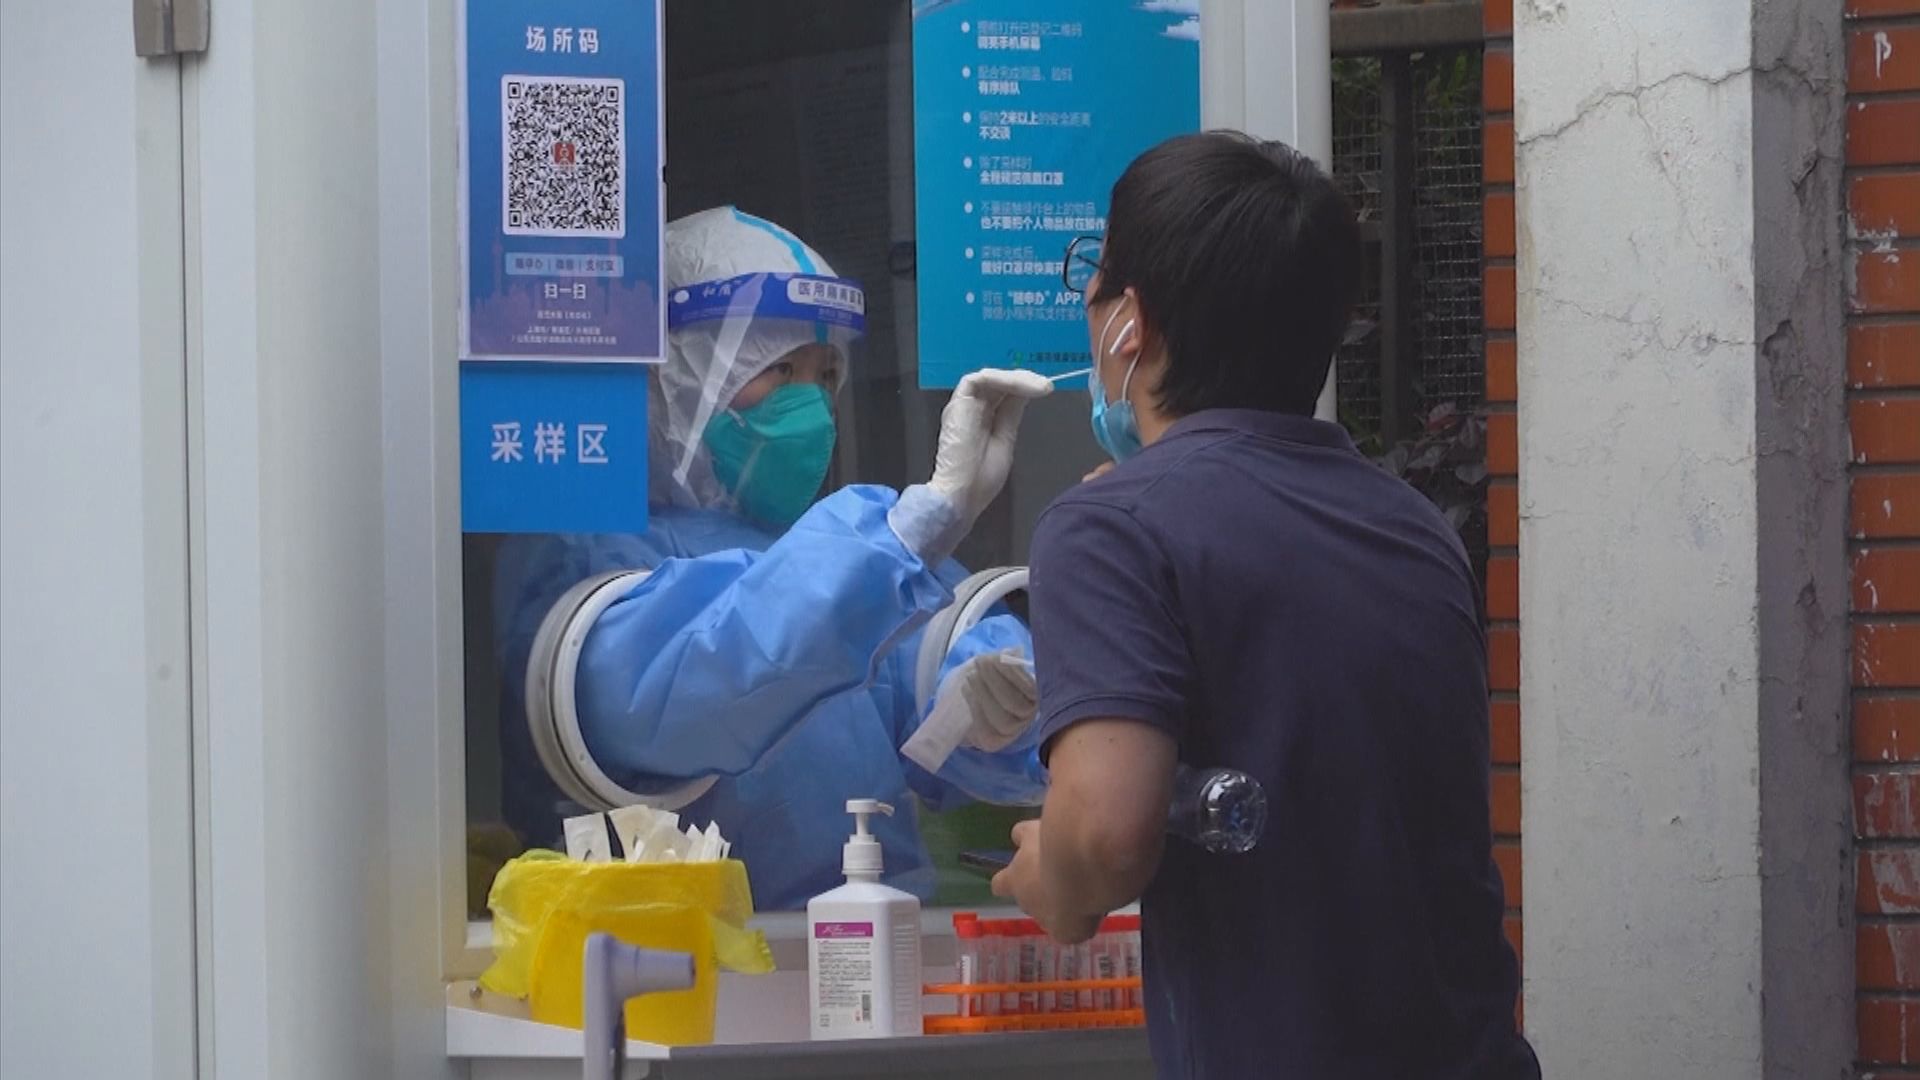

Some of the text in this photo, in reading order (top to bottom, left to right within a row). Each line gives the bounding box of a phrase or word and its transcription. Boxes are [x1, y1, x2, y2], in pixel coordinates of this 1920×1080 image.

[526, 26, 600, 55] 场所码
[978, 81, 1020, 95] 有序排队
[979, 126, 1011, 141] 不交谈
[544, 282, 587, 300] 扫一扫
[1055, 291, 1081, 305] APP
[491, 422, 608, 464] 采样区
